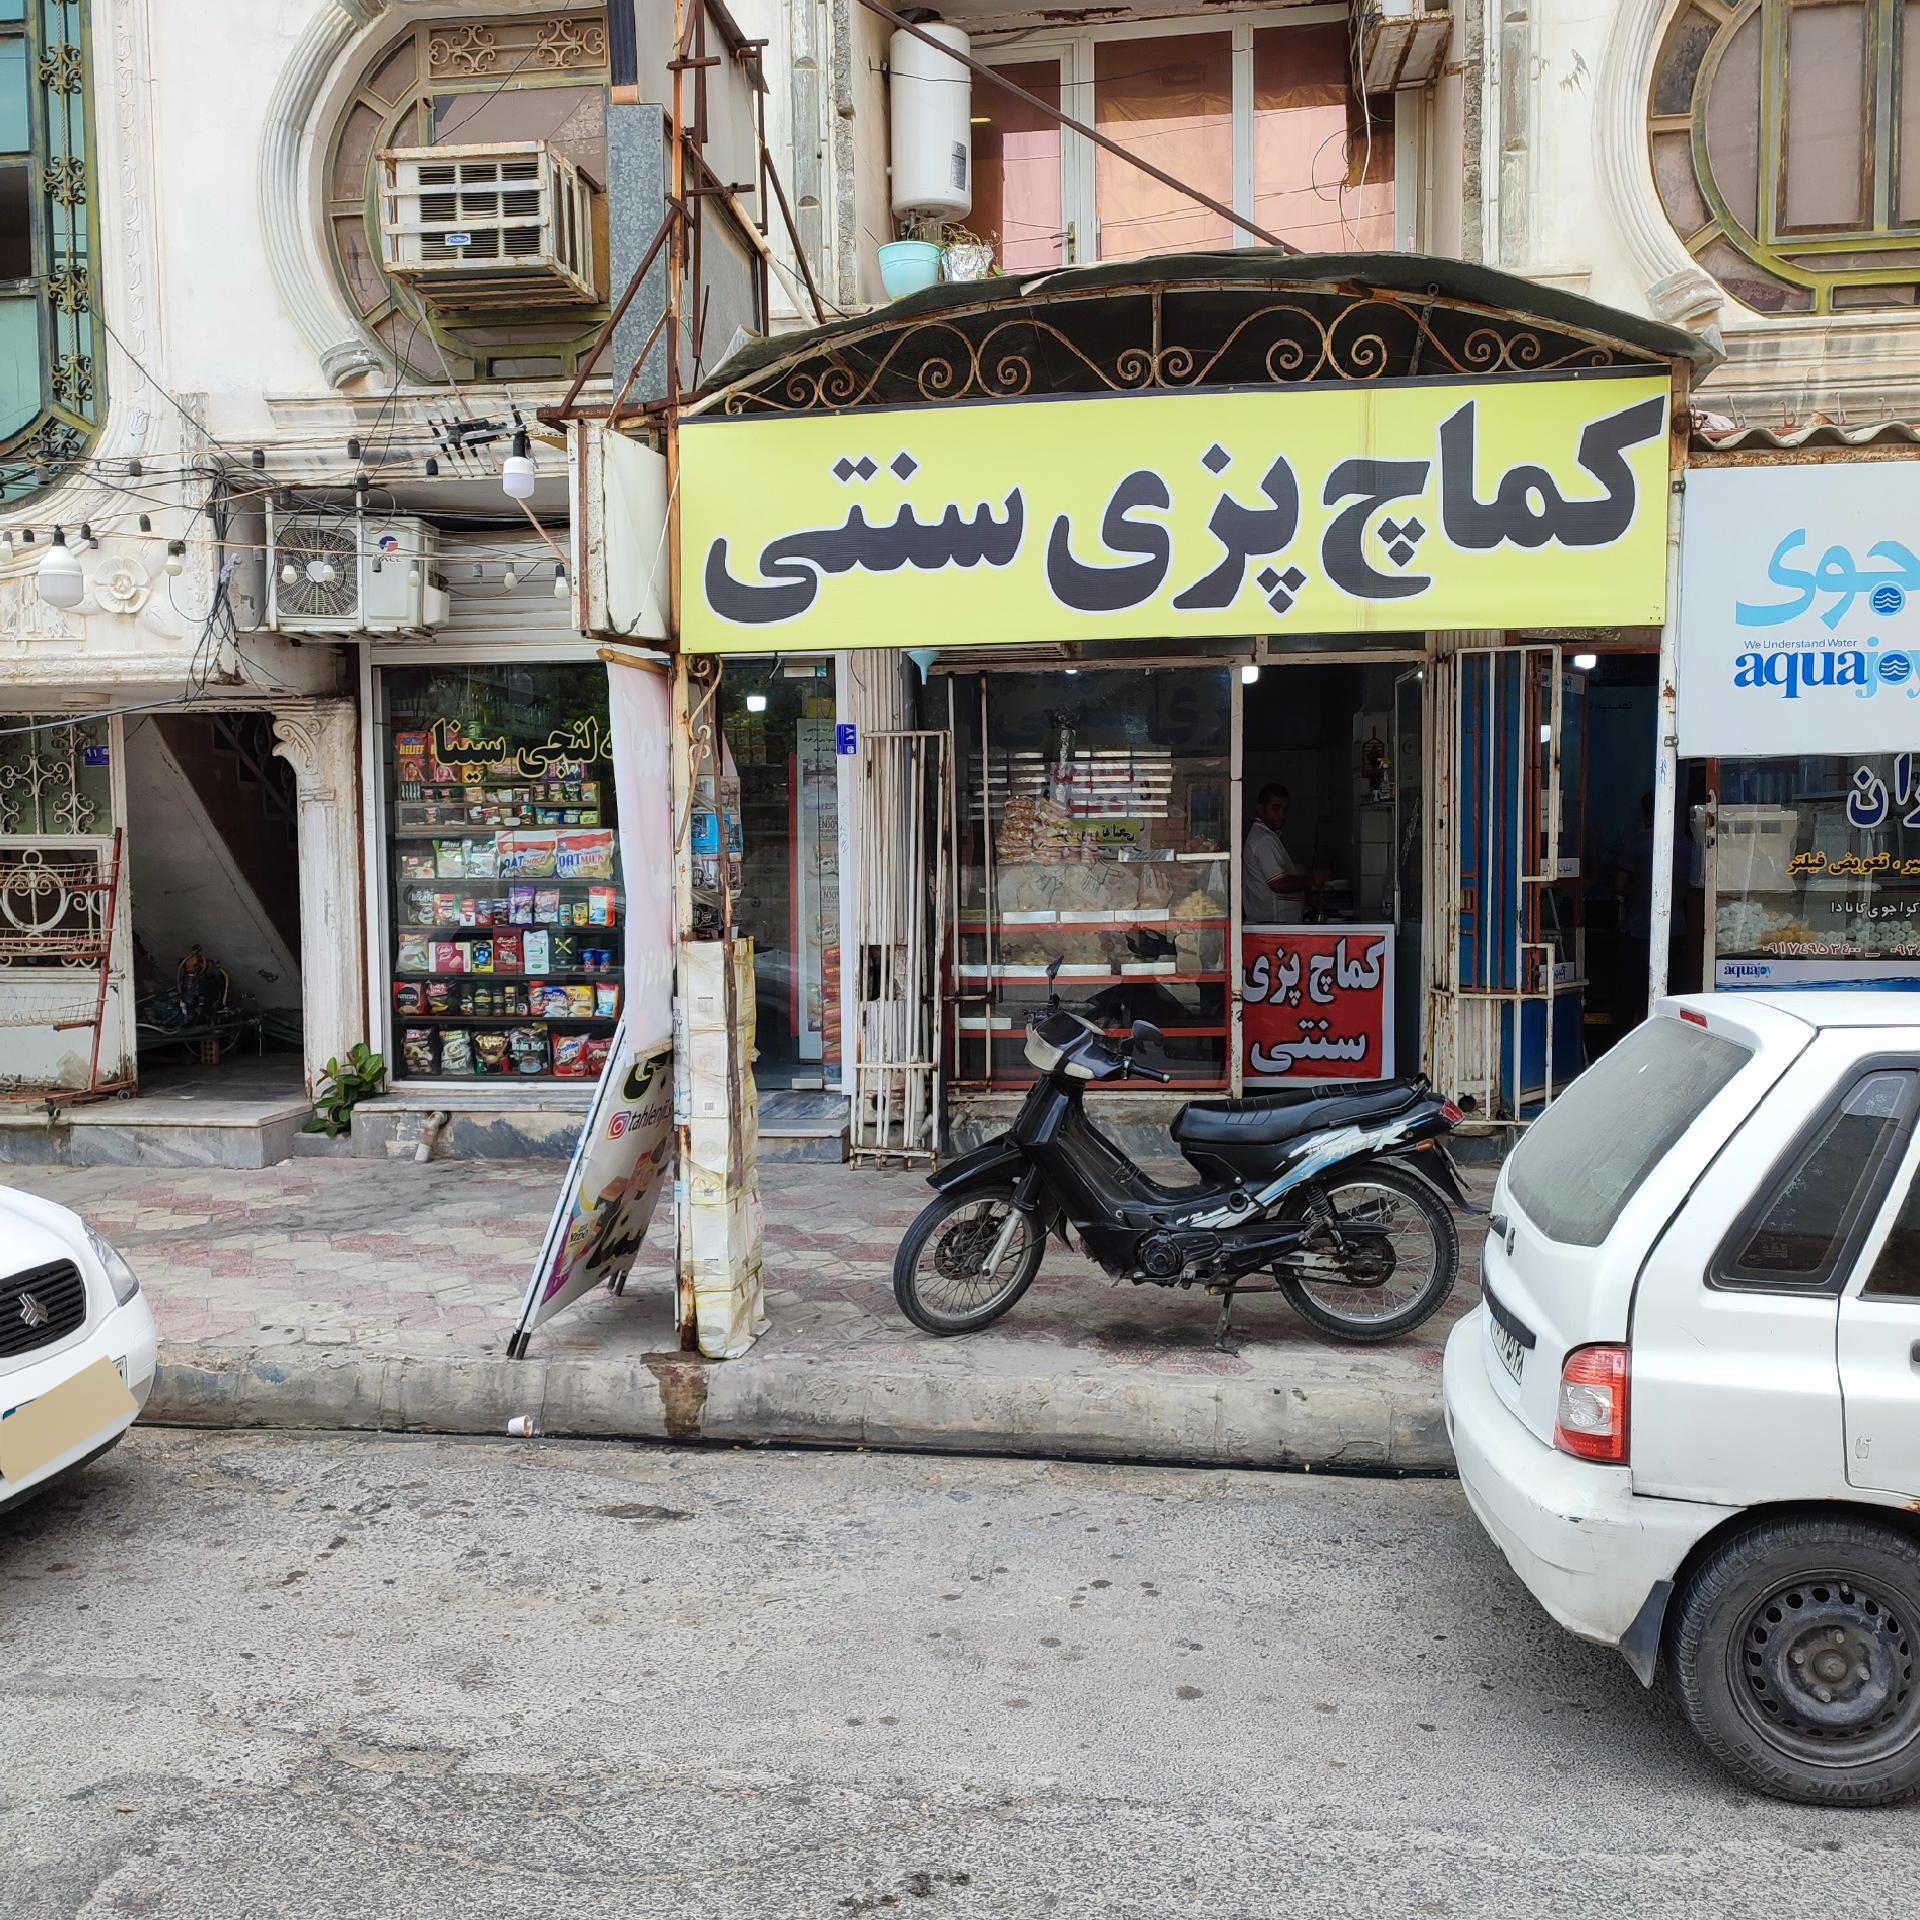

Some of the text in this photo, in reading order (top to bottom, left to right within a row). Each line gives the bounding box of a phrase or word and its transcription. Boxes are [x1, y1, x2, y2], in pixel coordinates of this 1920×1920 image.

[704, 395, 1668, 625] کماچ پزی سنتی
[1744, 638, 1858, 649] We Understand Water
[432, 717, 506, 783] سینا
[516, 715, 598, 778] لنجی
[559, 854, 581, 867] OAT
[1785, 850, 1826, 876] فیلتر
[1829, 852, 1890, 876] تعویض
[1242, 936, 1386, 1006] کماچ پزی
[1250, 1019, 1366, 1073] سنتی
